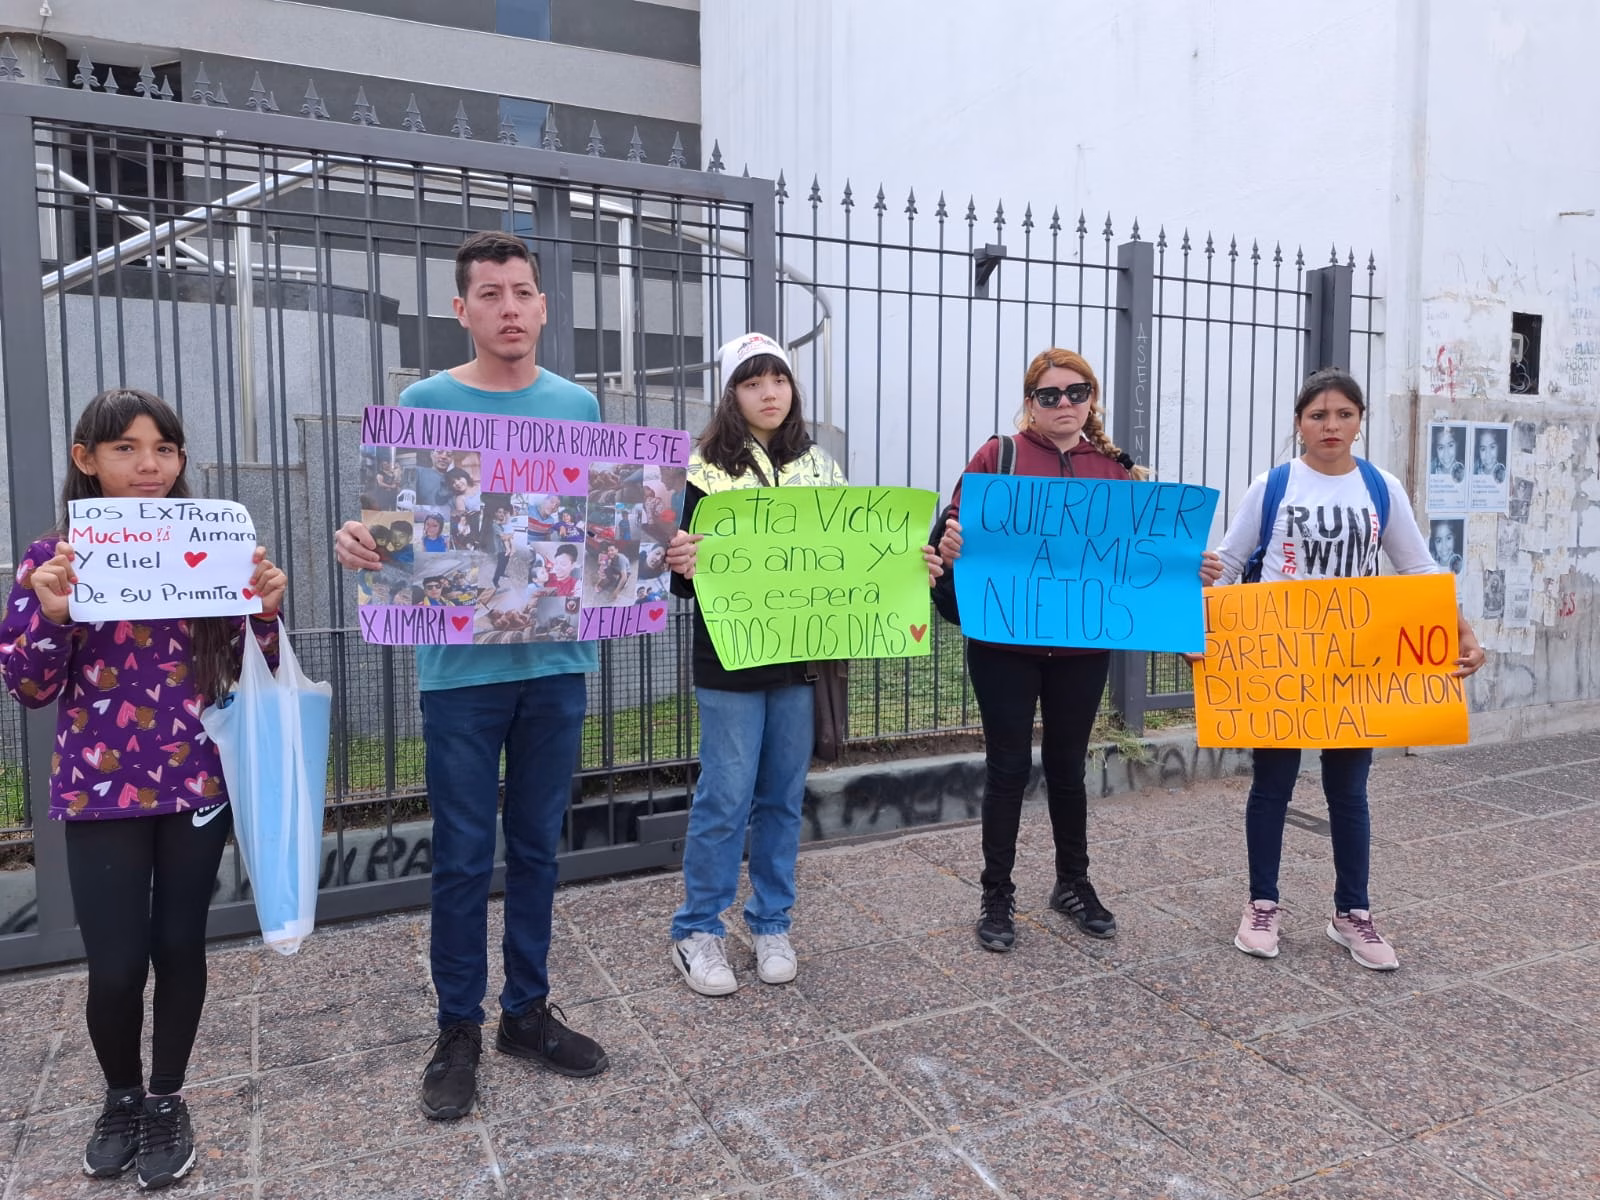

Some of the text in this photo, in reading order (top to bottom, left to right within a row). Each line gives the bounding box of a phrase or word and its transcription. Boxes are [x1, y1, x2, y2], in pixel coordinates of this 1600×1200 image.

[362, 407, 683, 464] NADA NI NADIE PODRA BORRAR ESTE
[490, 458, 559, 493] AMOR
[981, 479, 1206, 539] QUIERO VER
[1286, 505, 1371, 538] RUN
[765, 546, 844, 572] ama
[1029, 537, 1162, 589] A MIS
[1282, 542, 1296, 575] LIKE
[764, 582, 880, 610] espera
[984, 575, 1134, 641] NIETOS
[1203, 586, 1370, 633] IGUALDAD
[362, 608, 447, 644] X AIMARA
[582, 606, 647, 640] Y ELIEL
[706, 612, 907, 666] TODOS LOS DIAS
[1396, 624, 1449, 667] NO
[1205, 671, 1463, 706] DISCRIMINACION
[1215, 705, 1387, 741] JUDICIAL
